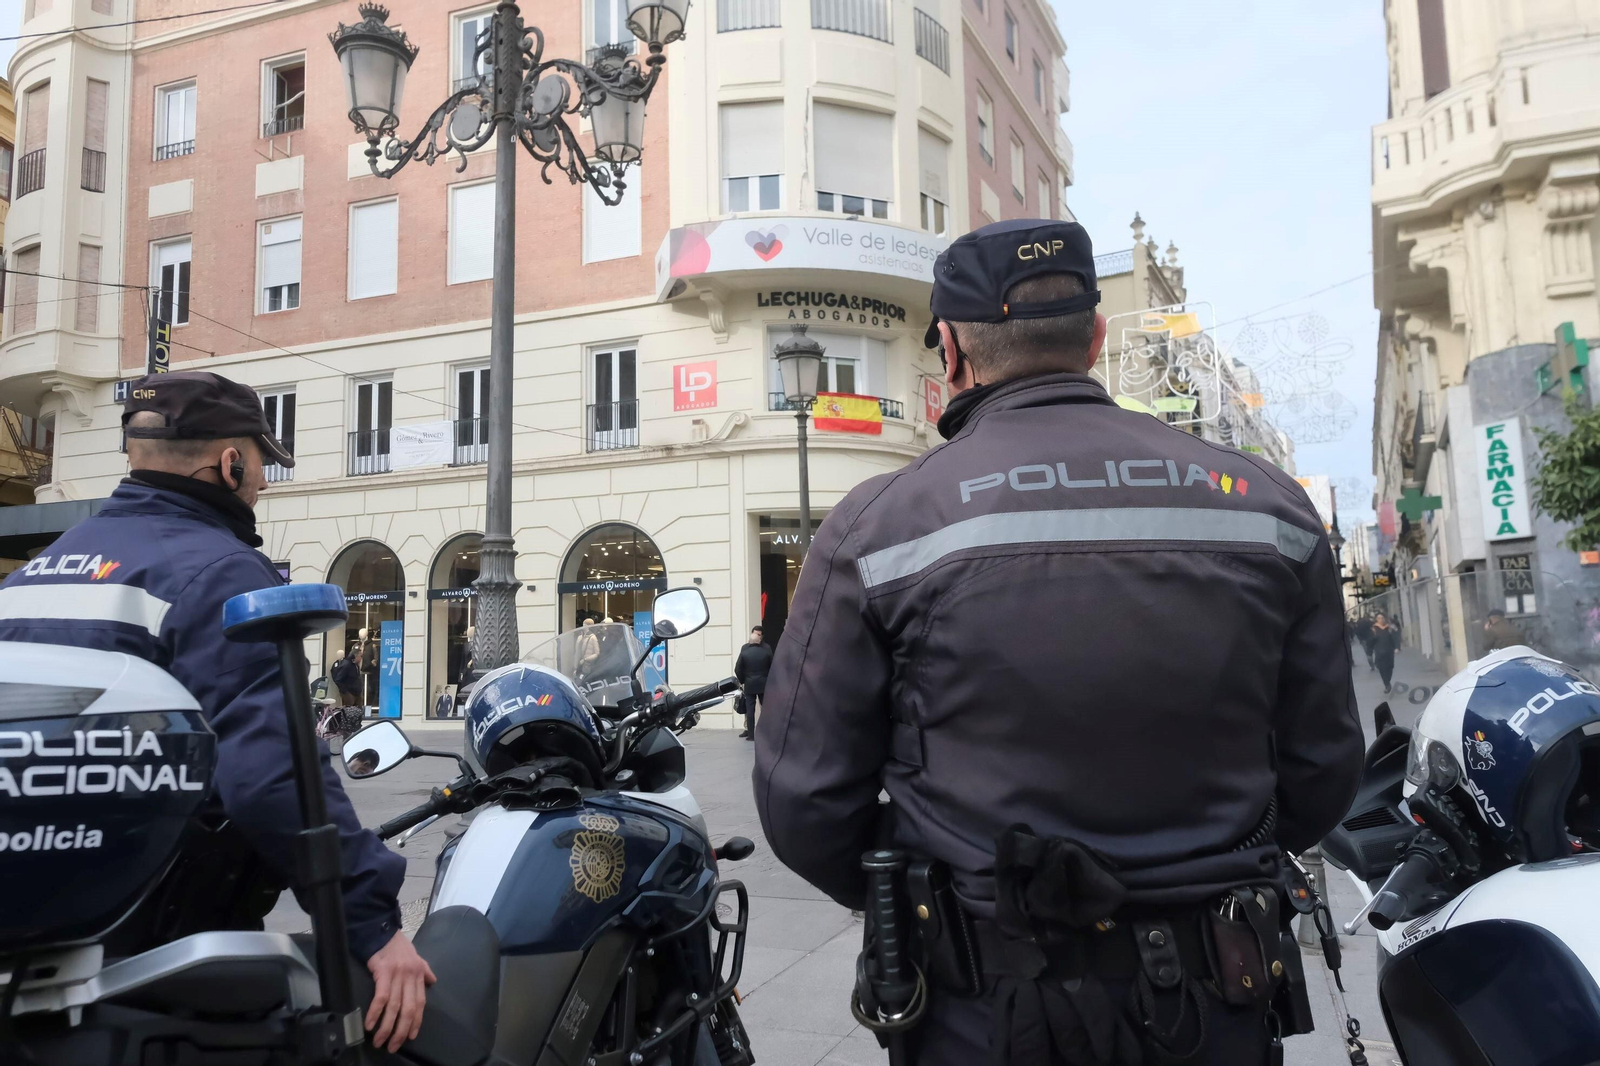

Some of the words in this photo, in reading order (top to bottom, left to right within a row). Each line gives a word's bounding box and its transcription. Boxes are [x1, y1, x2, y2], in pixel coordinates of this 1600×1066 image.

[803, 227, 853, 246] Valle
[860, 232, 885, 251] de
[1017, 240, 1065, 261] CNP
[858, 253, 924, 274] asistencias
[788, 309, 890, 329] ABOGADOS
[115, 382, 128, 401] H
[132, 389, 156, 400] CNP
[676, 401, 715, 410] ABOGADOS
[959, 460, 1220, 504] POLICIA
[1486, 423, 1518, 536] FARMACIA
[614, 581, 640, 589] MORENO
[1468, 779, 1506, 827] CNP
[1397, 926, 1437, 952] HONDA
